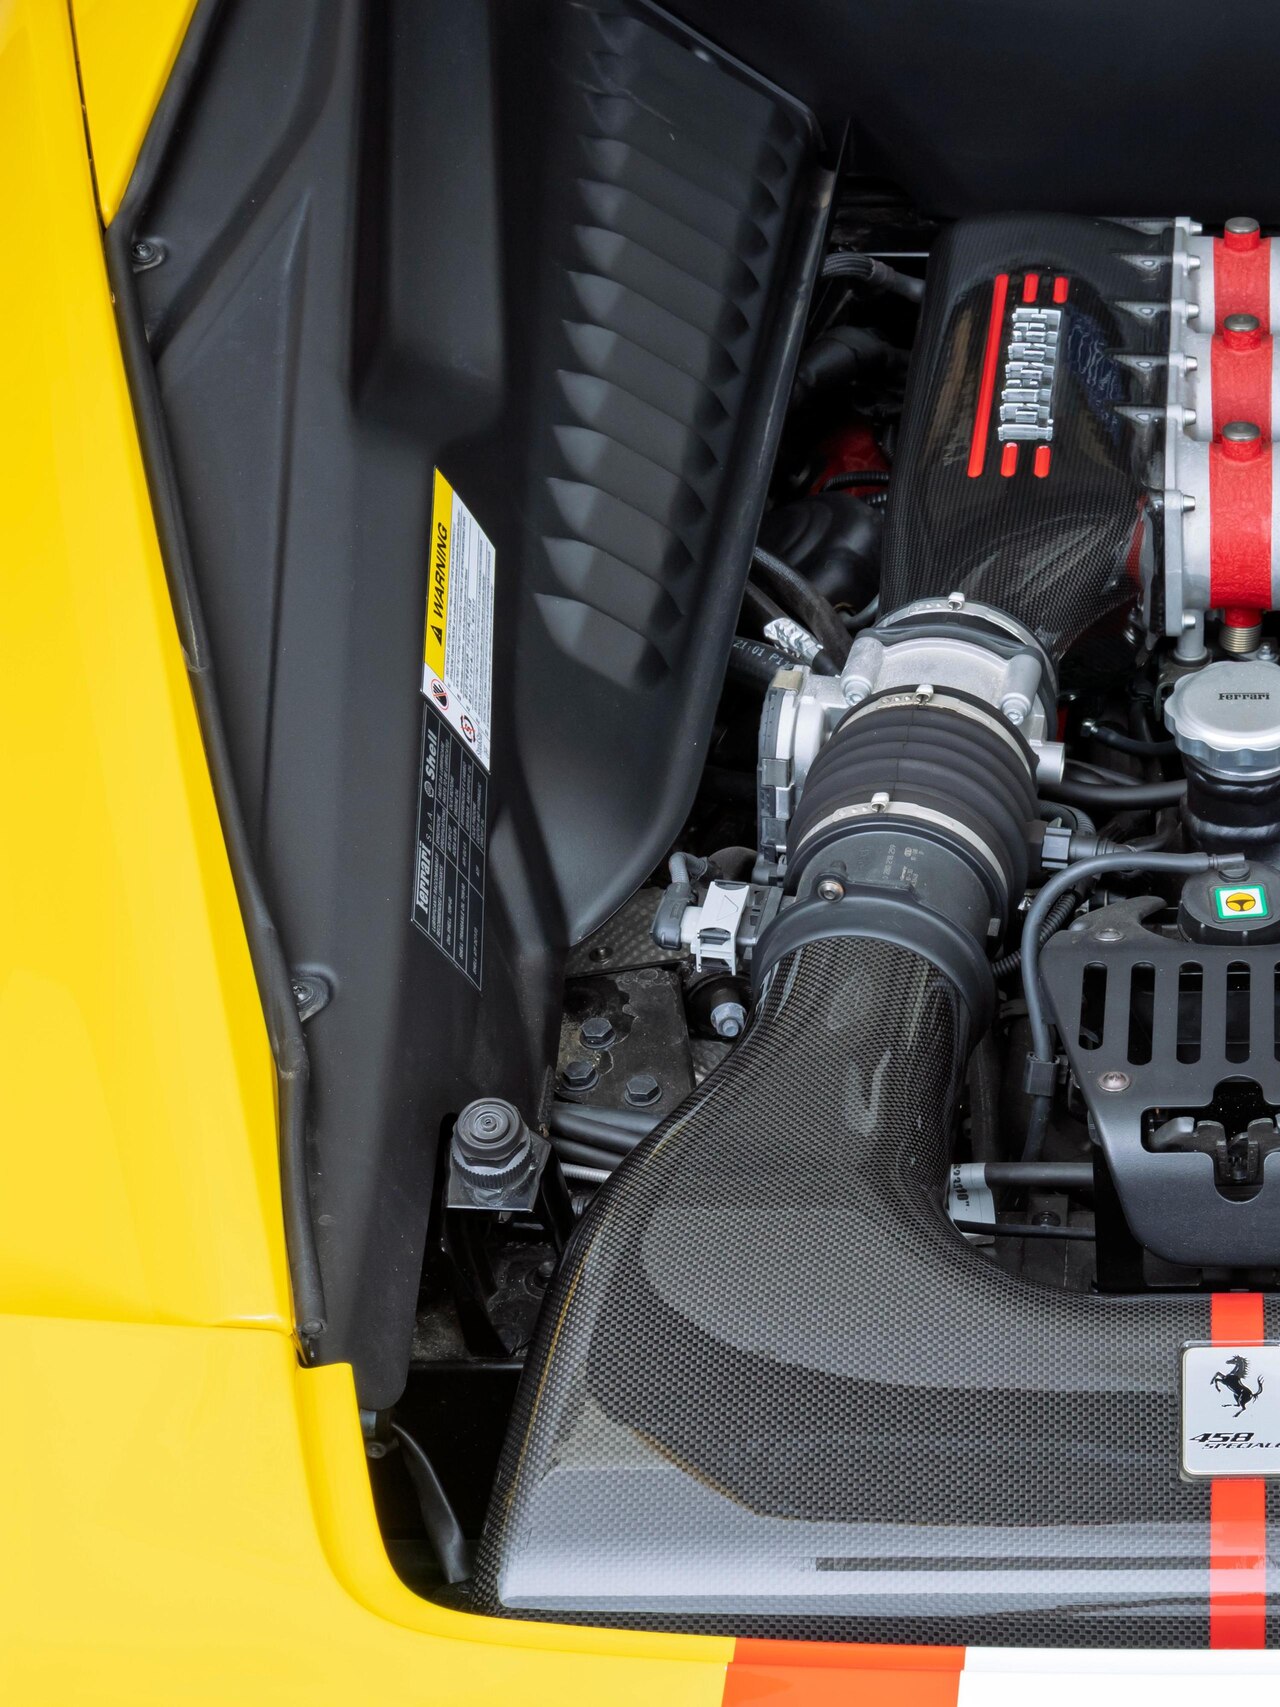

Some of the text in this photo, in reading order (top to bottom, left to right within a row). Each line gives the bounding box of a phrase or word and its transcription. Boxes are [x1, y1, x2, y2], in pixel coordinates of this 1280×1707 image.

[433, 522, 448, 618] WARNING
[1218, 692, 1270, 701] Ferrari
[425, 729, 437, 781] Shell
[416, 839, 431, 914] Ferrari
[1189, 1432, 1254, 1442] 458
